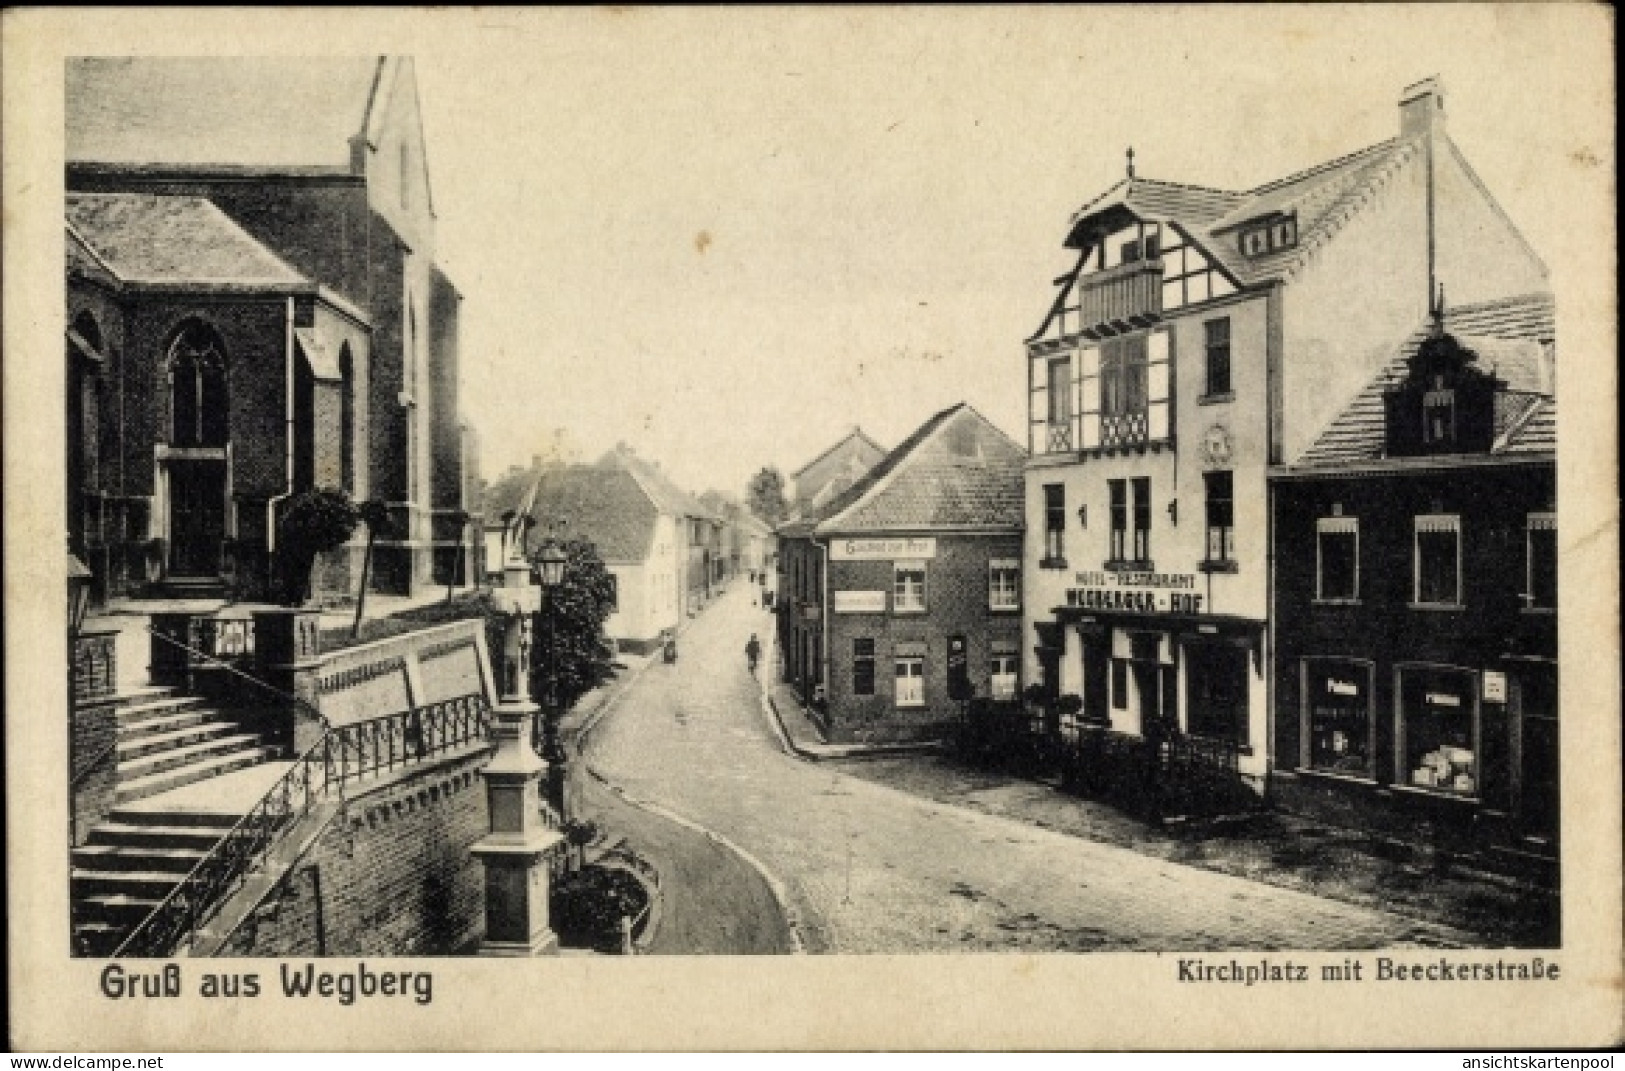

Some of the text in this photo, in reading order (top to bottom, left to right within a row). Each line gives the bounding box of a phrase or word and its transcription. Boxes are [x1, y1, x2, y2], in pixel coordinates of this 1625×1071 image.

[101, 962, 433, 1005] Gruß aus Wegberg
[1178, 958, 1560, 986] Kirchplatz mit Beeckerstraße
